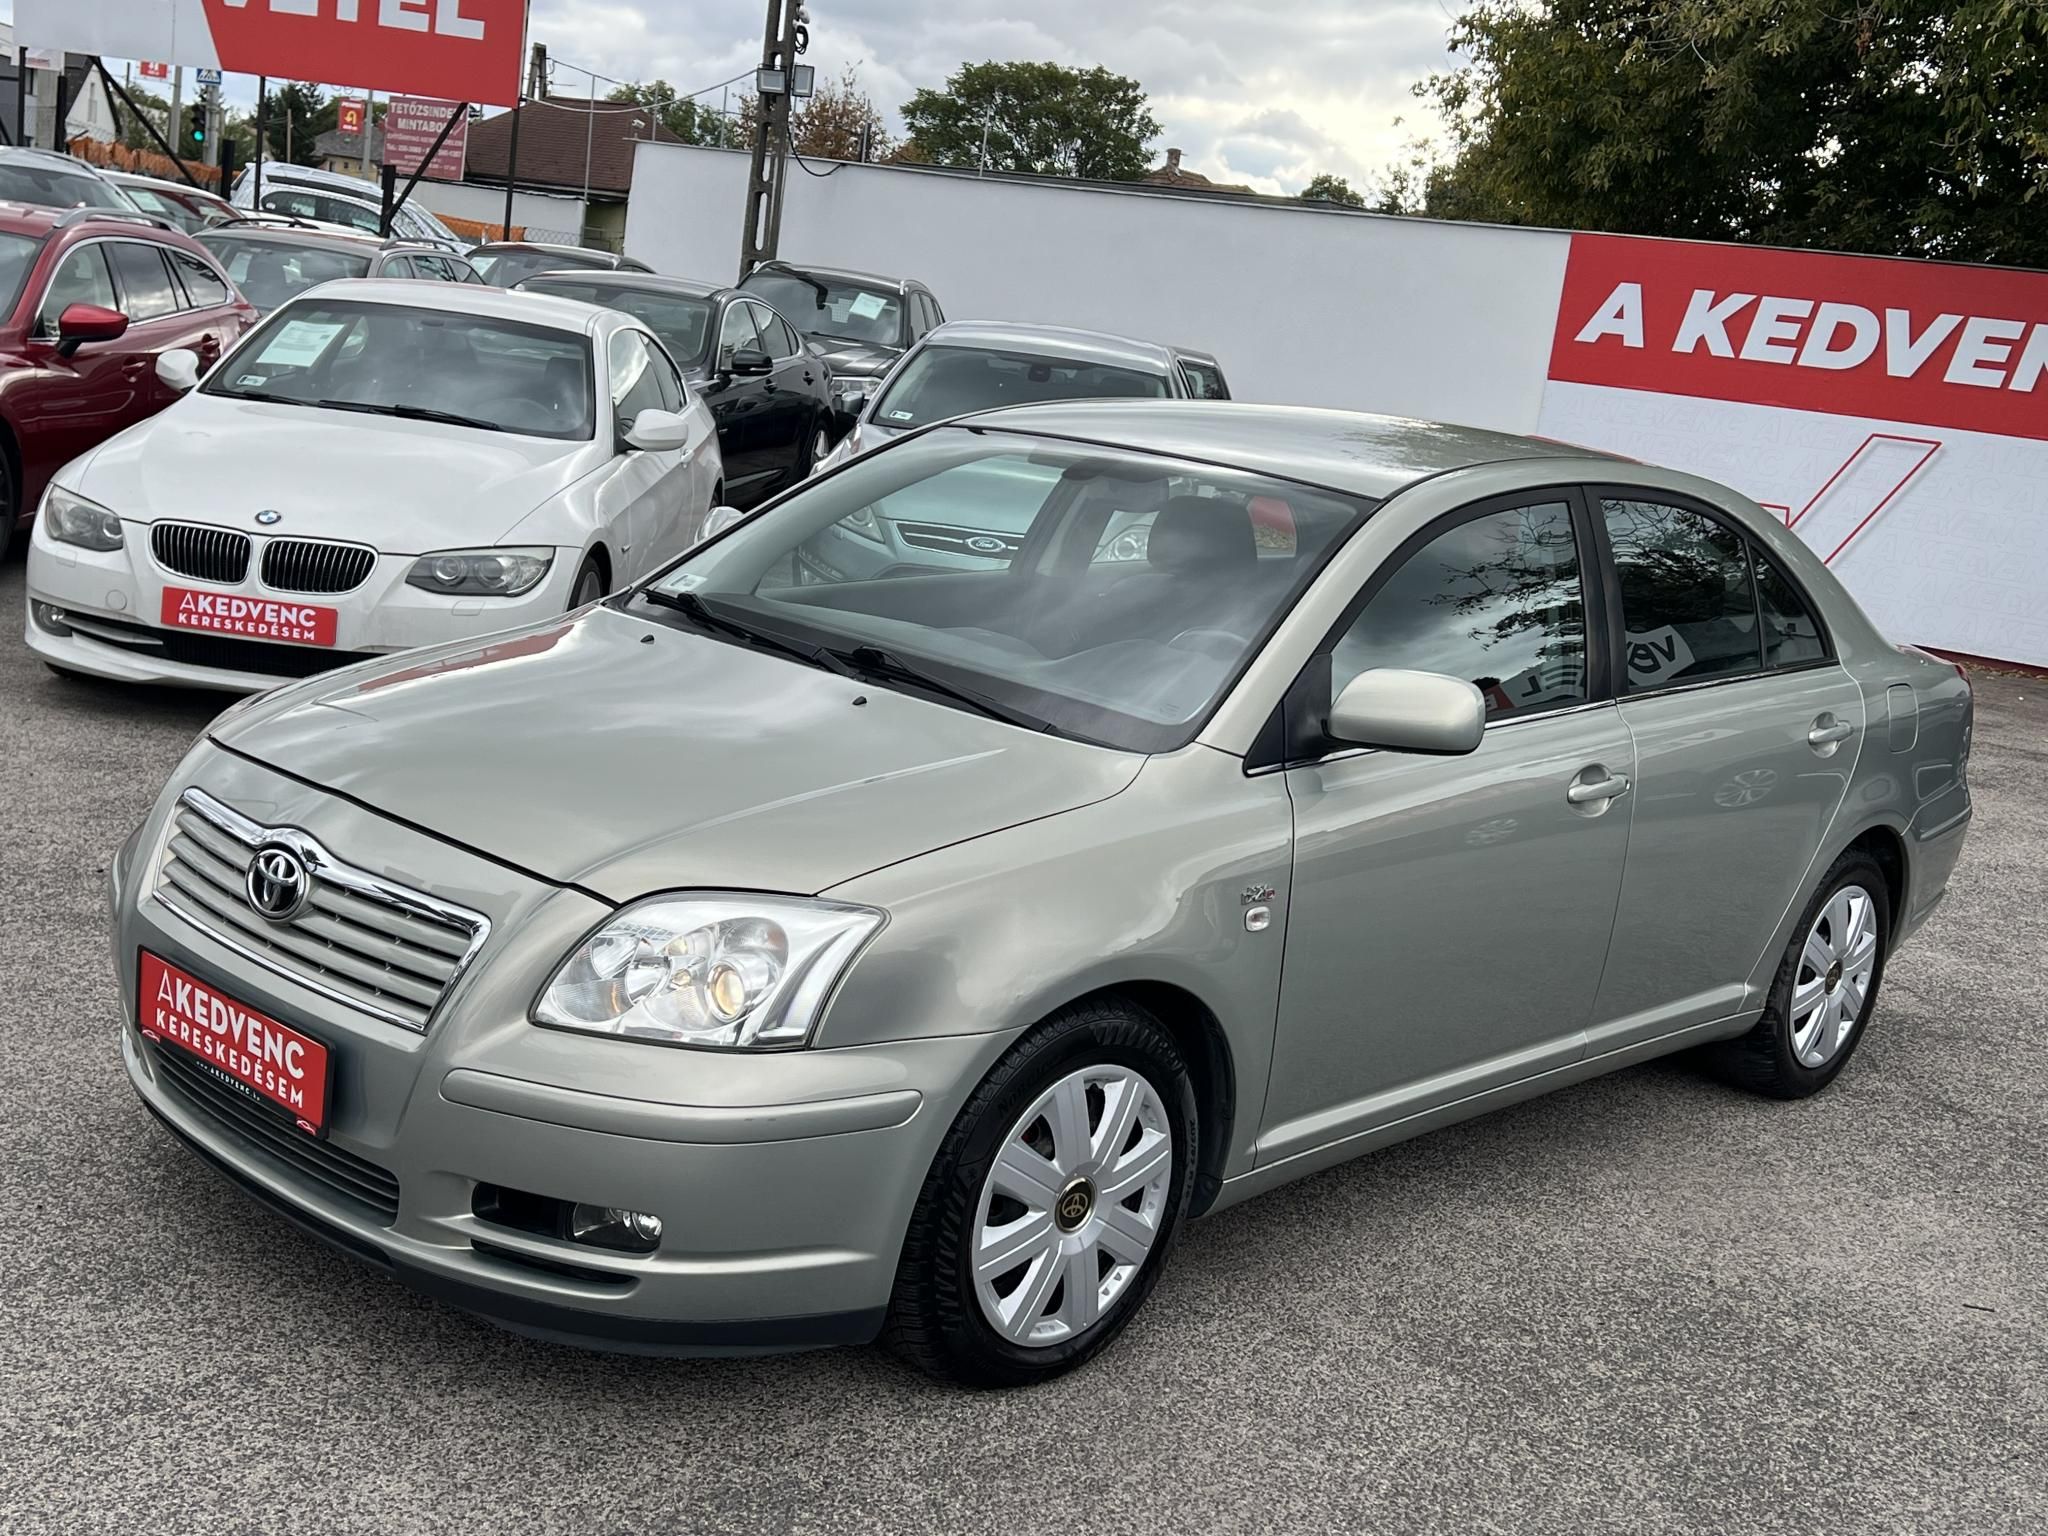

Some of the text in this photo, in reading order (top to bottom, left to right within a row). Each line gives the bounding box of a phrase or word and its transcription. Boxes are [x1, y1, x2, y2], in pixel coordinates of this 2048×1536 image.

[390, 101, 464, 120] TETŐZSINDE
[397, 118, 454, 134] MINTABO
[1574, 282, 1644, 348] A
[178, 612, 315, 640] KERESKEDÉSEM
[179, 592, 316, 627] AKEDVENC
[157, 969, 304, 1079] AKEDVENC
[156, 1007, 303, 1109] KERESKEDÉSEM
